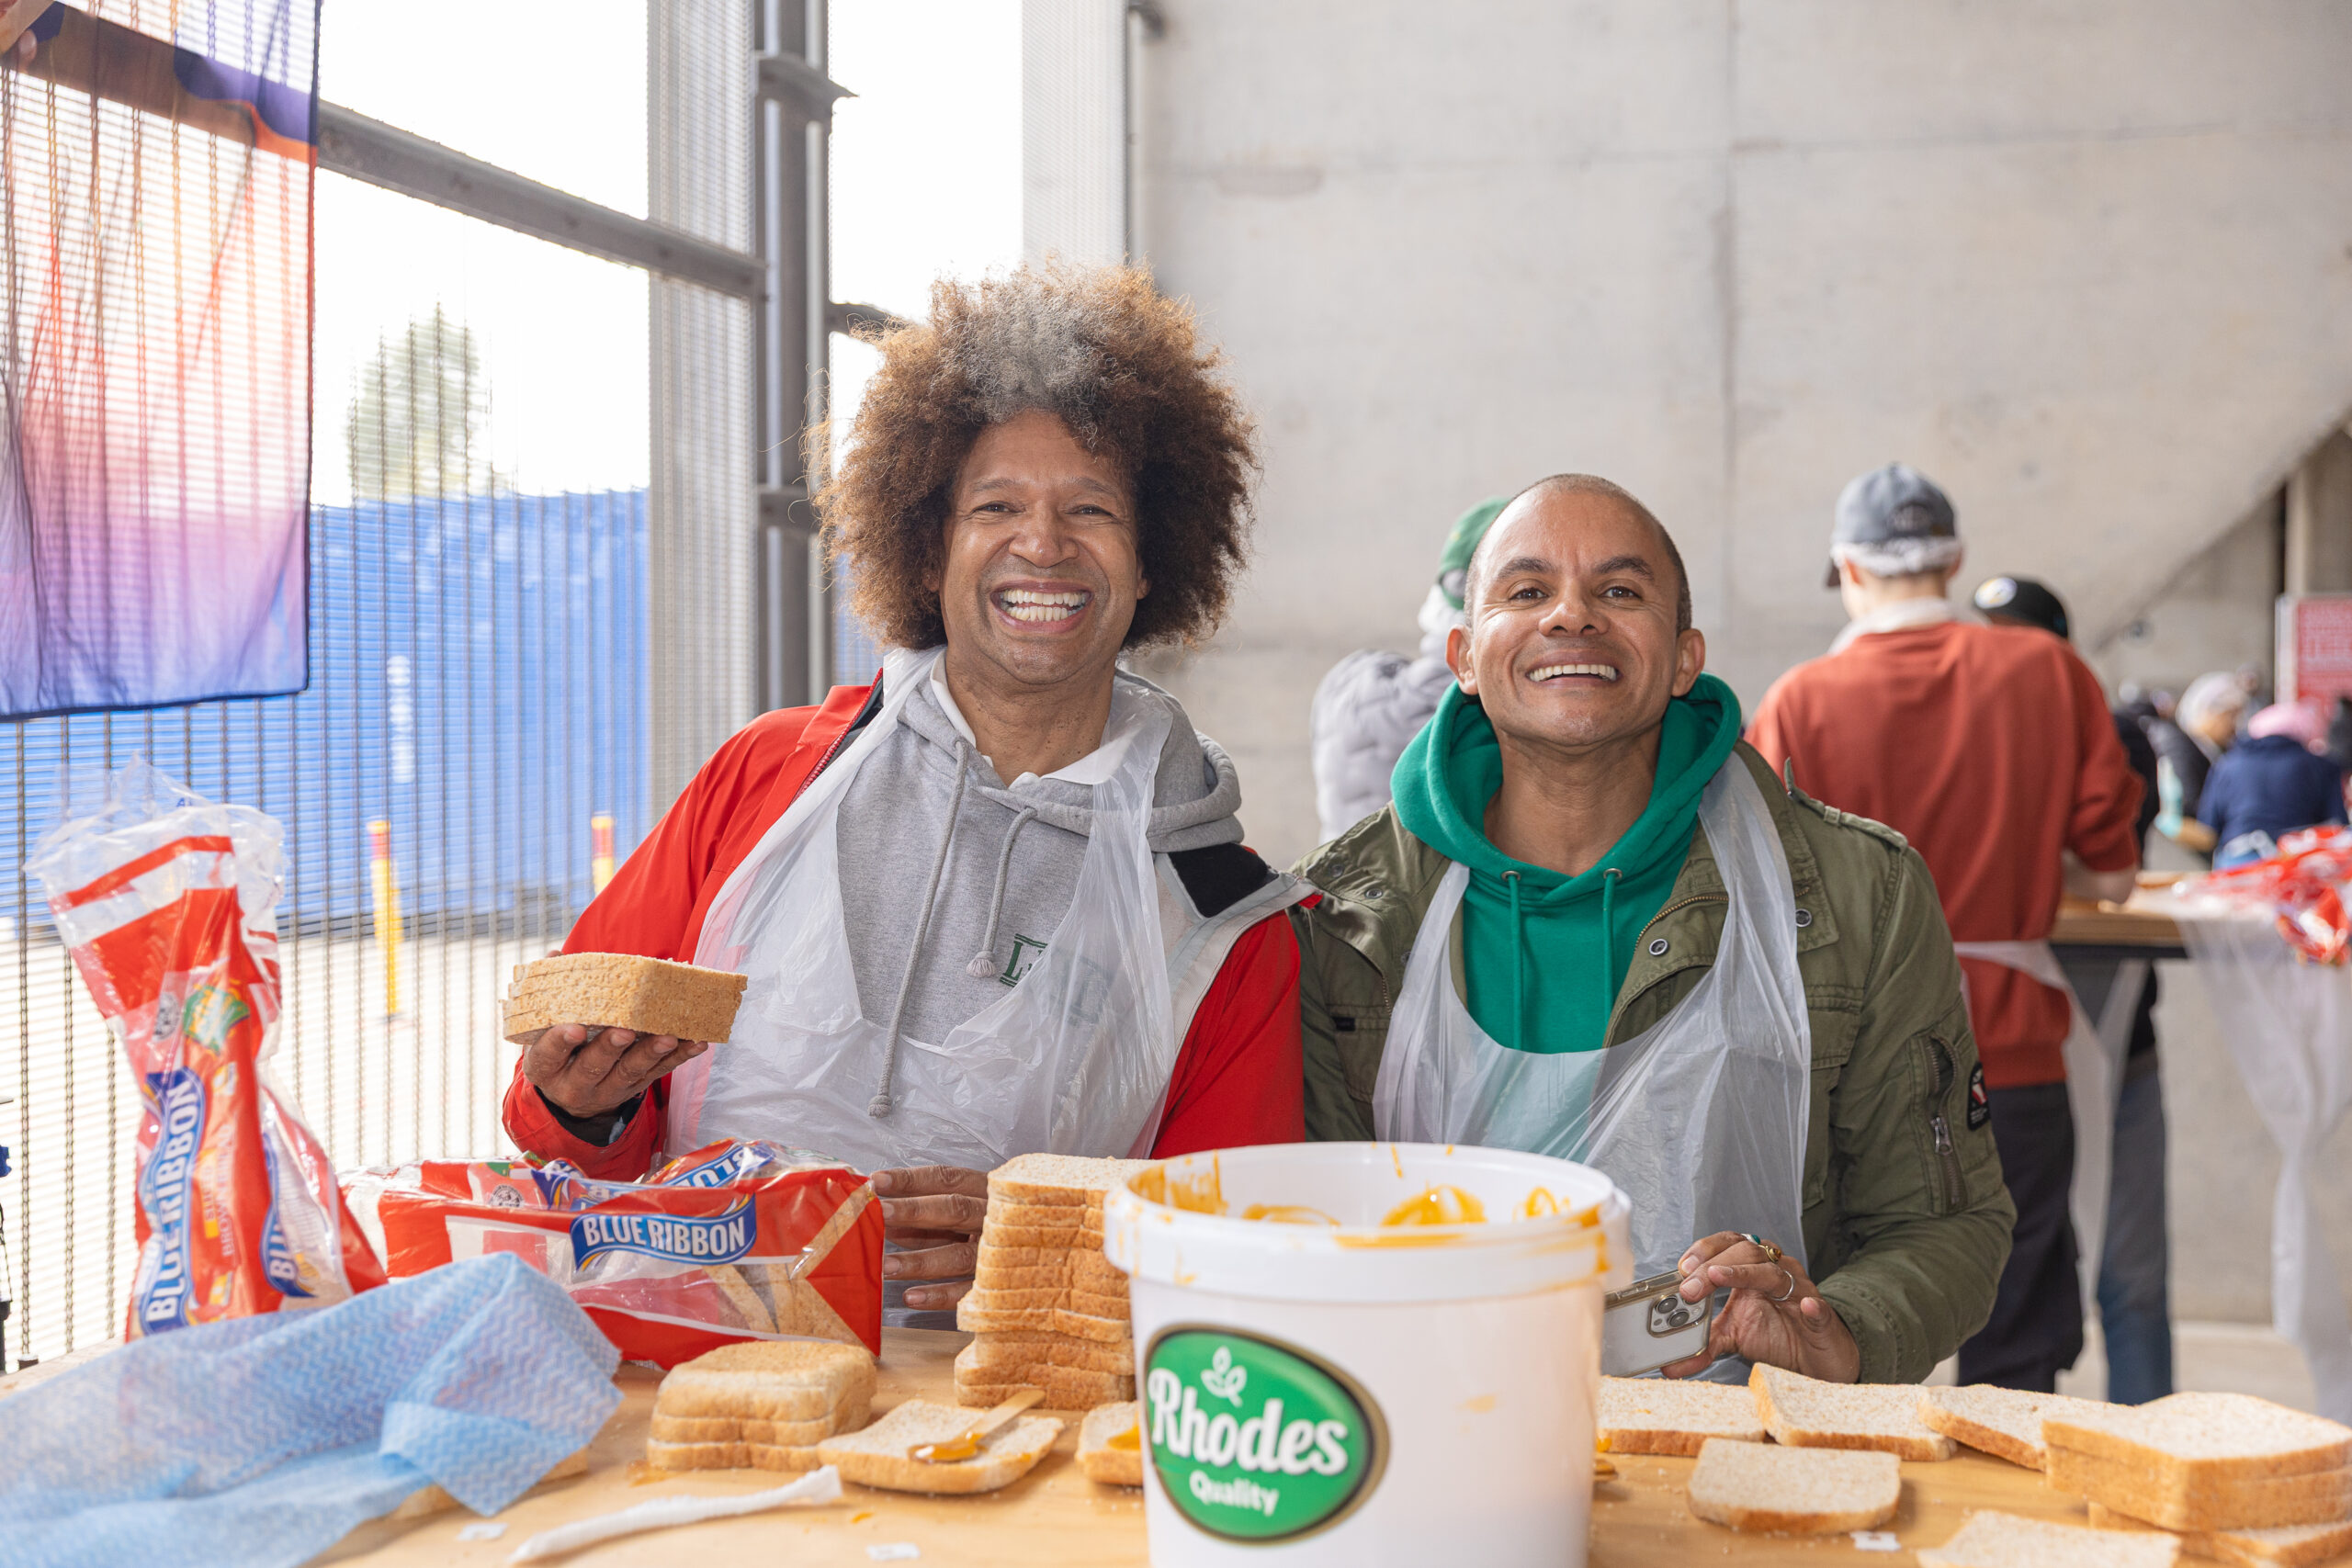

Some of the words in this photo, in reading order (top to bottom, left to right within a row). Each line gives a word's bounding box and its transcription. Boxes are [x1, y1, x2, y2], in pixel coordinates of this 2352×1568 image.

[155, 1080, 198, 1224] RIBBON
[217, 1186, 235, 1257] BROWN
[269, 1224, 296, 1280] BL
[582, 1215, 647, 1247] BLUE
[647, 1216, 745, 1257] RIBBON
[1148, 1368, 1348, 1475] Rhodes
[1189, 1470, 1279, 1517] Quality
